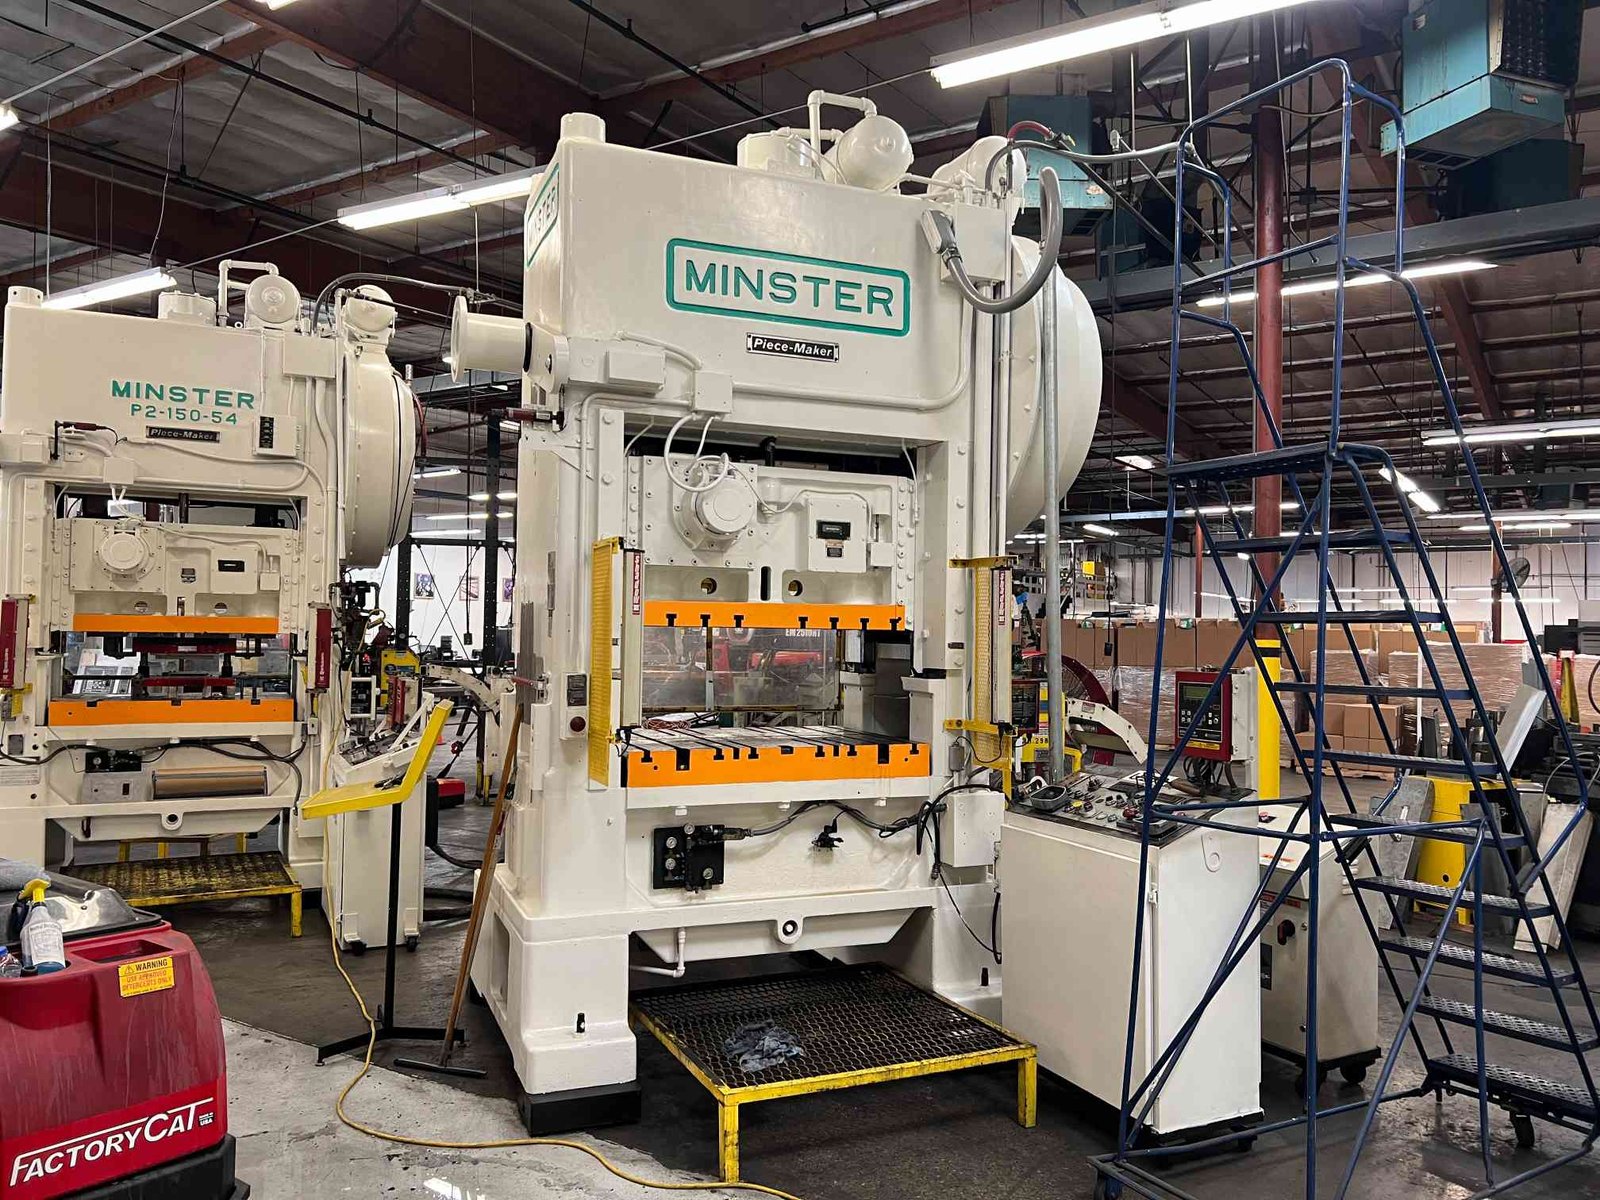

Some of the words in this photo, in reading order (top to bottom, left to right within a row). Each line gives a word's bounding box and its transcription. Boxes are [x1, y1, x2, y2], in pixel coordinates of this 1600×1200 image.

[686, 259, 893, 317] MINSTER
[753, 338, 833, 358] Piece-Maker
[111, 379, 255, 410] MINSTER
[130, 403, 237, 425] P2-150-54
[150, 428, 214, 441] Piece-Maker
[135, 958, 168, 971] WARNING
